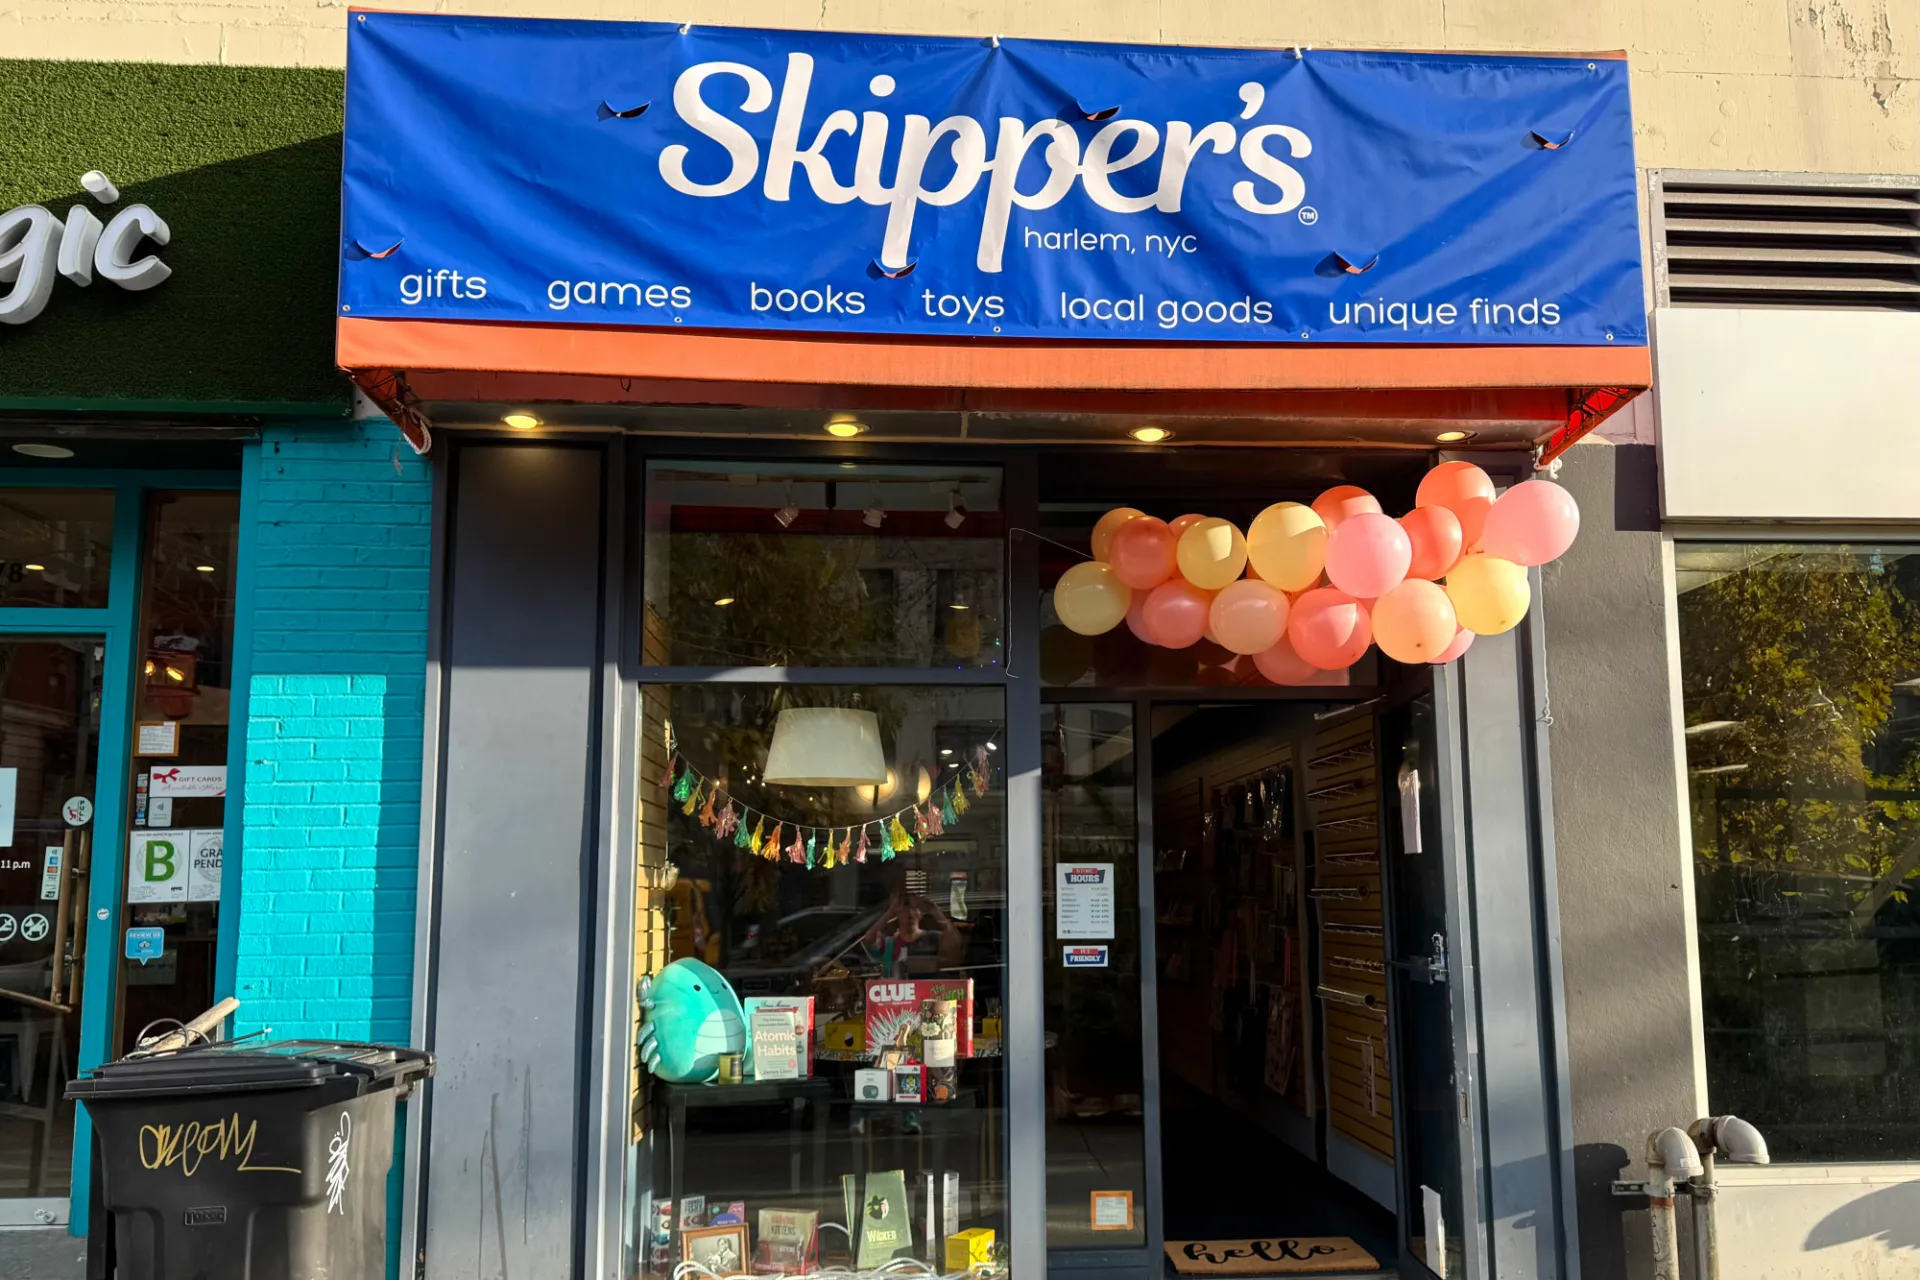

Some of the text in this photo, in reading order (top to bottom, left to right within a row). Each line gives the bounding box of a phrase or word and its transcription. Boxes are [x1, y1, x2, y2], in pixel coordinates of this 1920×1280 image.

[658, 51, 1313, 273] Skipper's
[1024, 226, 1198, 259] harlem, nyc
[400, 270, 1562, 332] gifts games books toys local goods unique finds
[144, 840, 175, 882] B
[200, 848, 223, 858] GRA
[193, 859, 222, 868] PEND
[1070, 874, 1100, 883] HOURS
[1070, 954, 1101, 962] FRIENDLY
[868, 983, 916, 1003] CLUE
[754, 1030, 796, 1042] Atomic
[757, 1044, 797, 1057] Habits
[1182, 1239, 1347, 1264] hello
